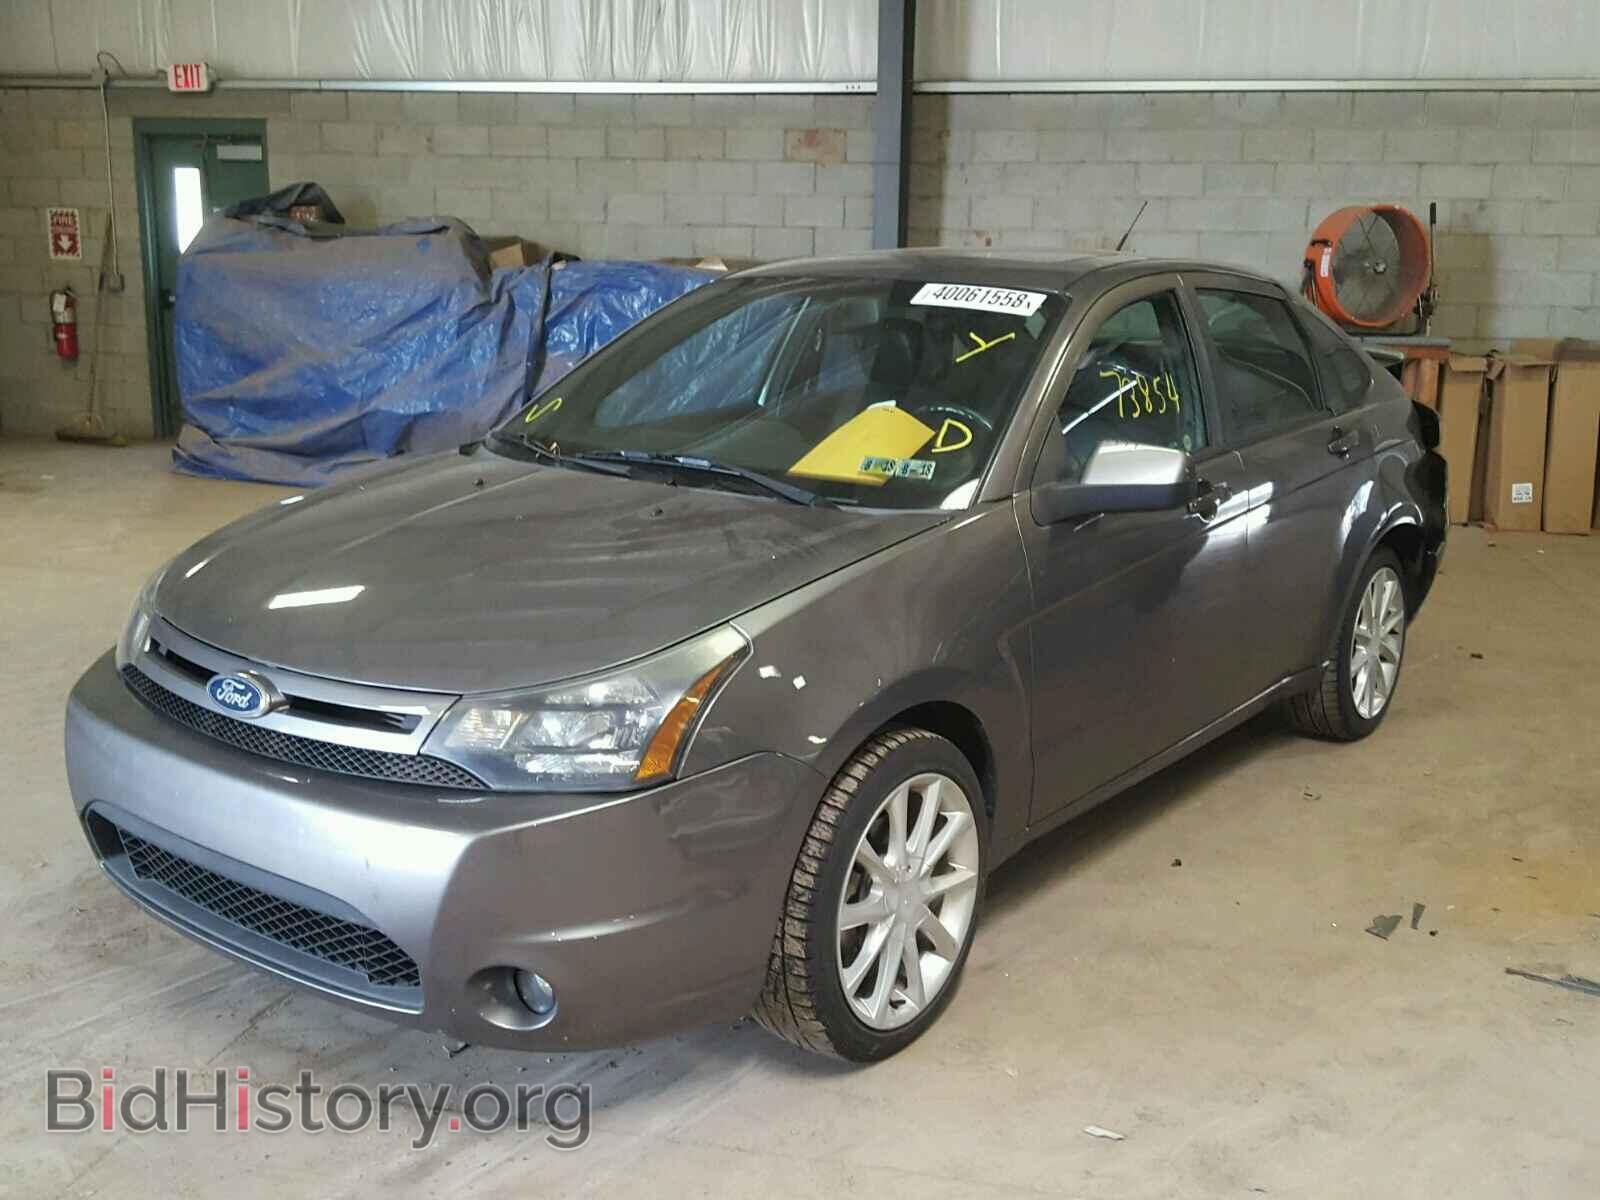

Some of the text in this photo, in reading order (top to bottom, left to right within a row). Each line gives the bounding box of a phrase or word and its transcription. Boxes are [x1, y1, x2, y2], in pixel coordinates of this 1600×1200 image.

[174, 64, 201, 88] EXIT
[933, 286, 1028, 308] 40061558
[955, 331, 1016, 362] Y
[931, 418, 972, 453] D
[216, 678, 252, 708] Ford
